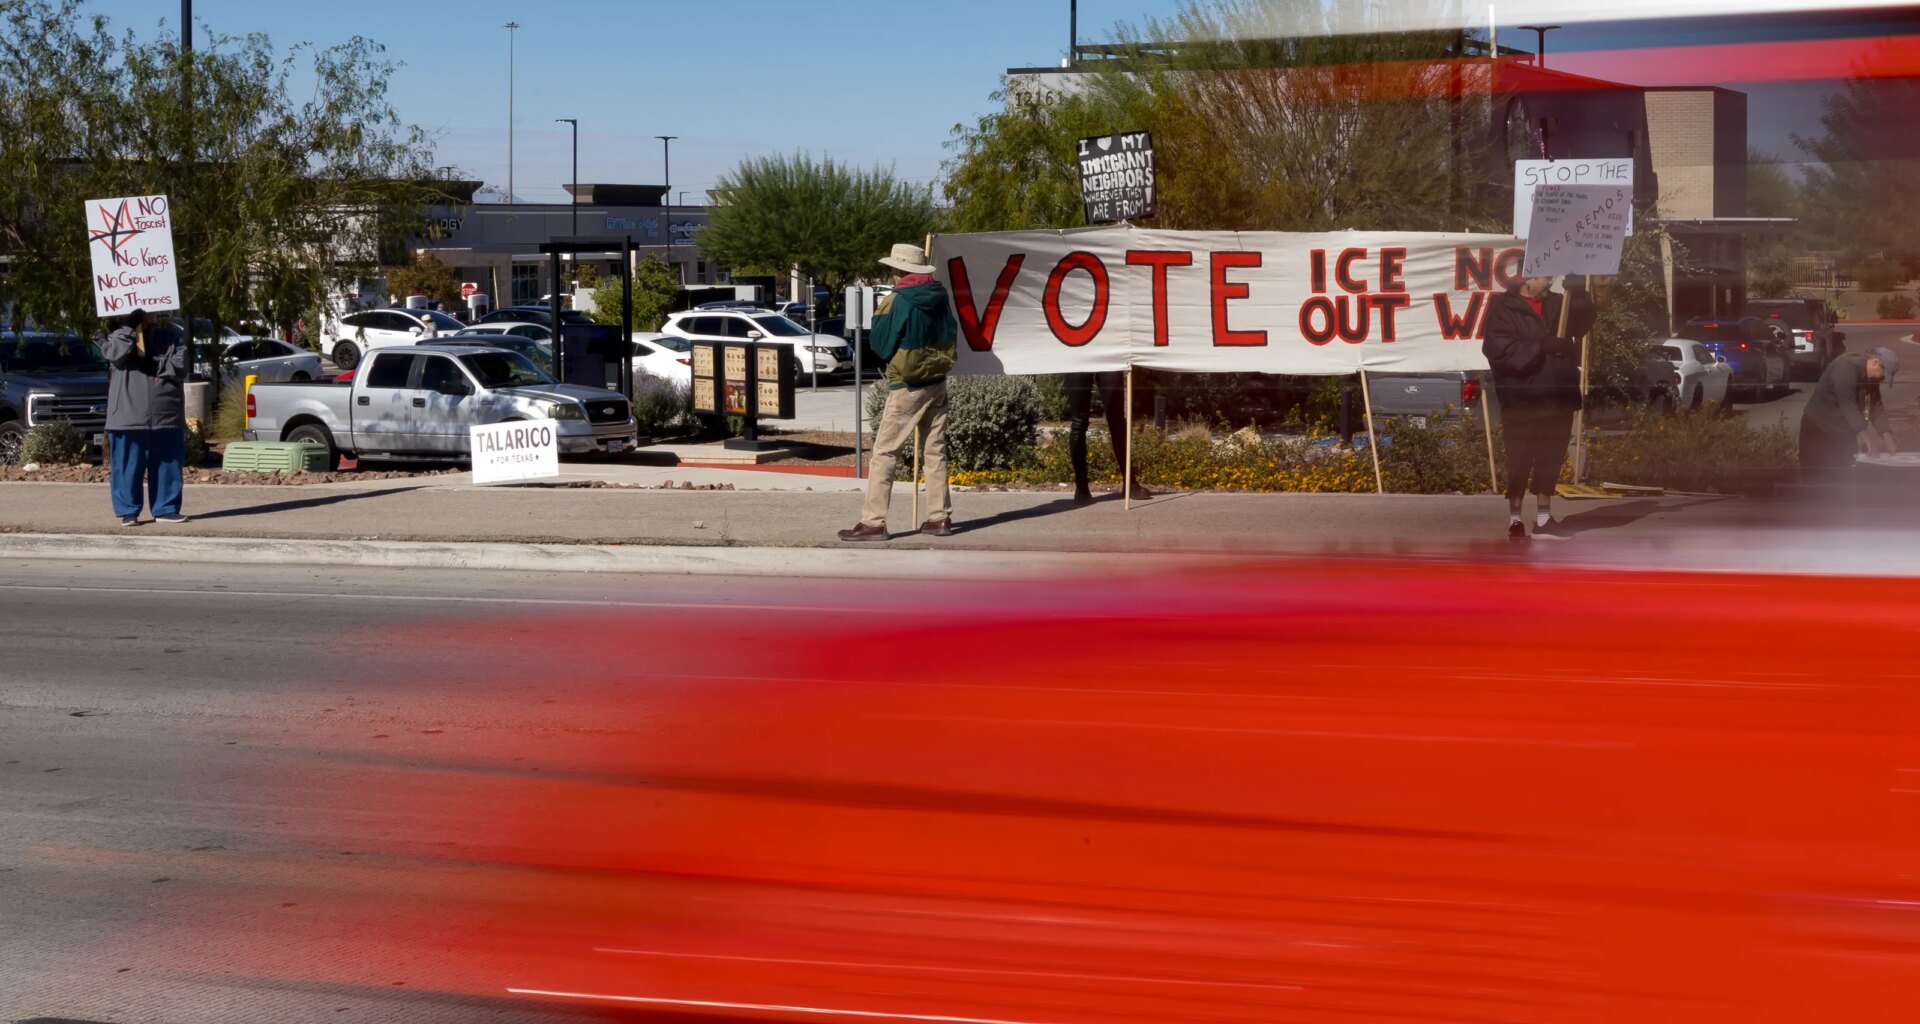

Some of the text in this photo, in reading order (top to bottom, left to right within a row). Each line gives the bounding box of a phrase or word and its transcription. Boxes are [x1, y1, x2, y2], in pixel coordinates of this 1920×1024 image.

[1079, 133, 1145, 156] I MY
[1081, 149, 1153, 175] IMMIGRANT
[1524, 161, 1629, 186] STOP THE
[1082, 167, 1154, 193] NEIGHBORS
[137, 196, 167, 215] NO
[1084, 187, 1142, 203] WHEREVER THEY
[133, 216, 167, 230] Fascist
[1093, 203, 1109, 218] ARE
[1526, 190, 1623, 274] VENCEREMOS
[140, 247, 169, 272] Kings
[1310, 247, 1407, 293] ICE
[119, 271, 157, 287] Crown
[124, 292, 172, 307] Thrones
[947, 249, 1268, 352] VOTE
[1300, 293, 1410, 345] OUT
[476, 426, 551, 453] TALARICO
[496, 454, 533, 464] FOR TEXAS
